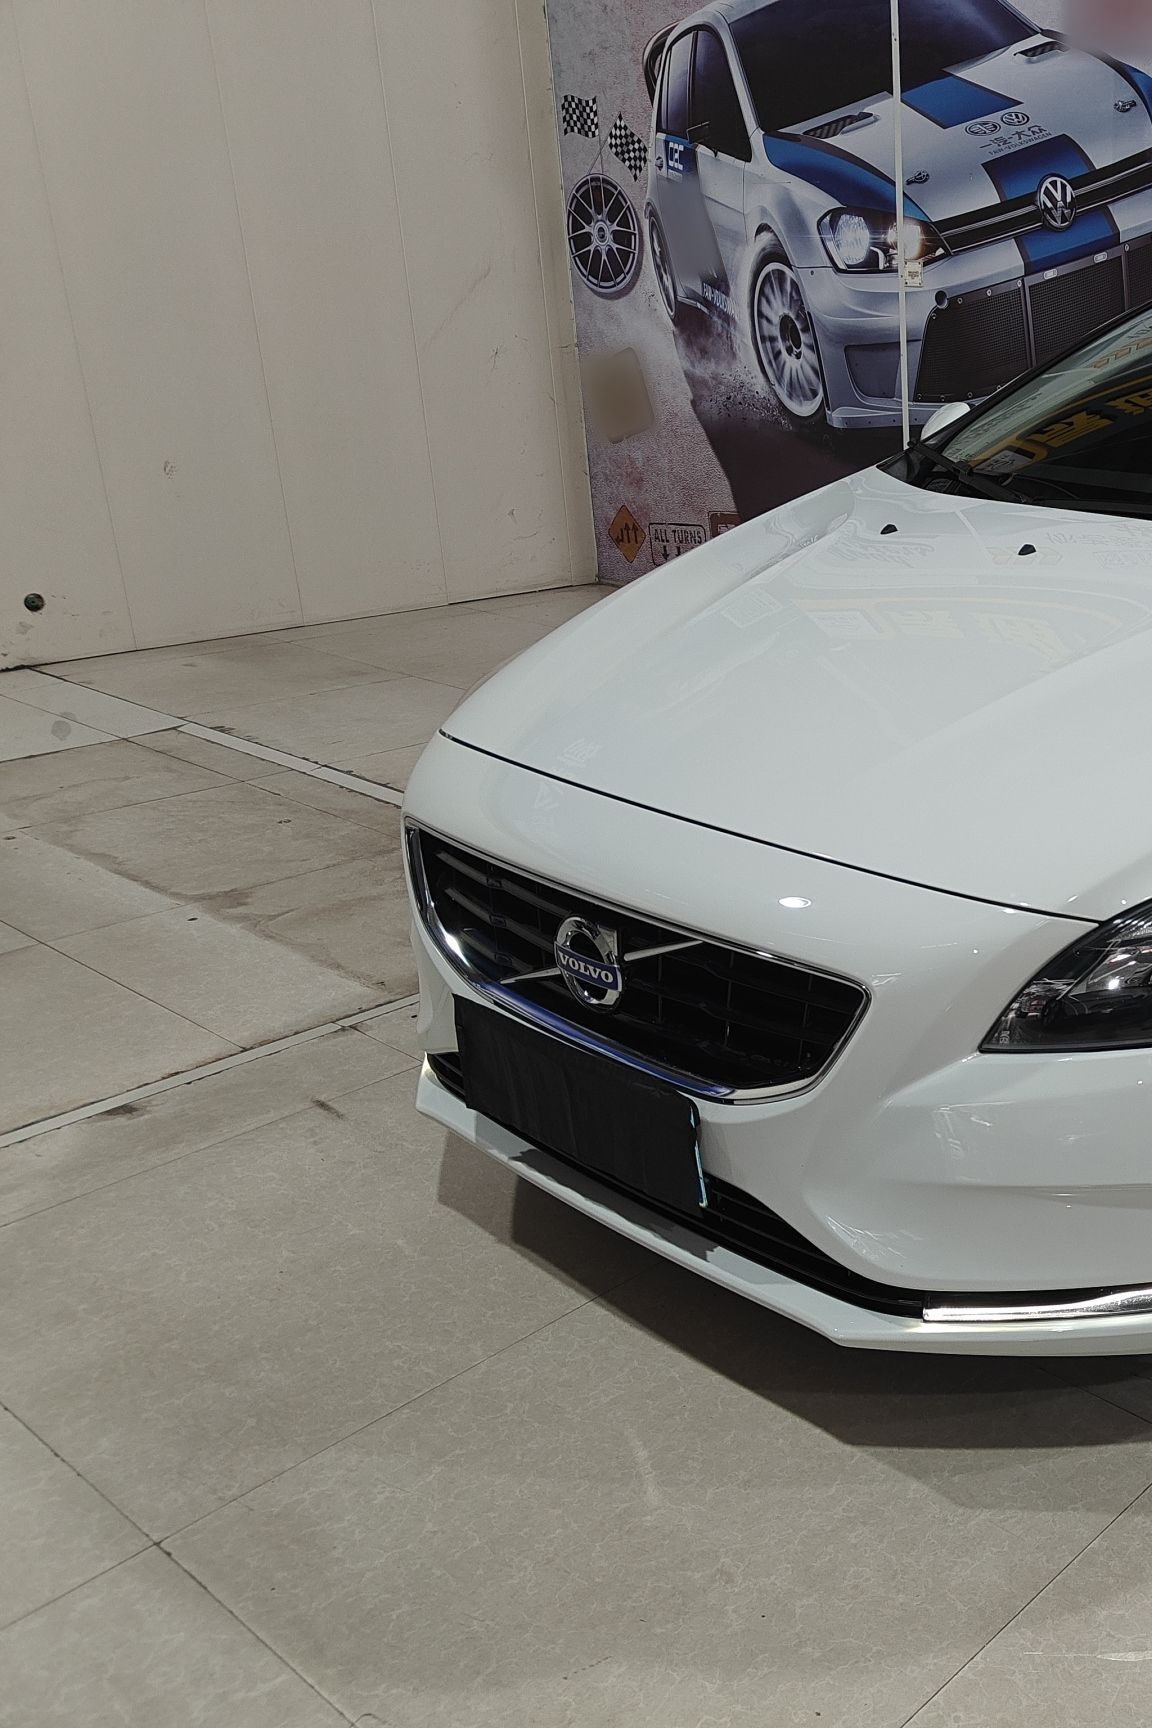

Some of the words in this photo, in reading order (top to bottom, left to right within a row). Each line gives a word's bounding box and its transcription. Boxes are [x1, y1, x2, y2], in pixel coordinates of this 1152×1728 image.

[654, 528, 669, 543] ALL
[672, 529, 702, 545] TURNS
[558, 950, 614, 983] VOLVO
